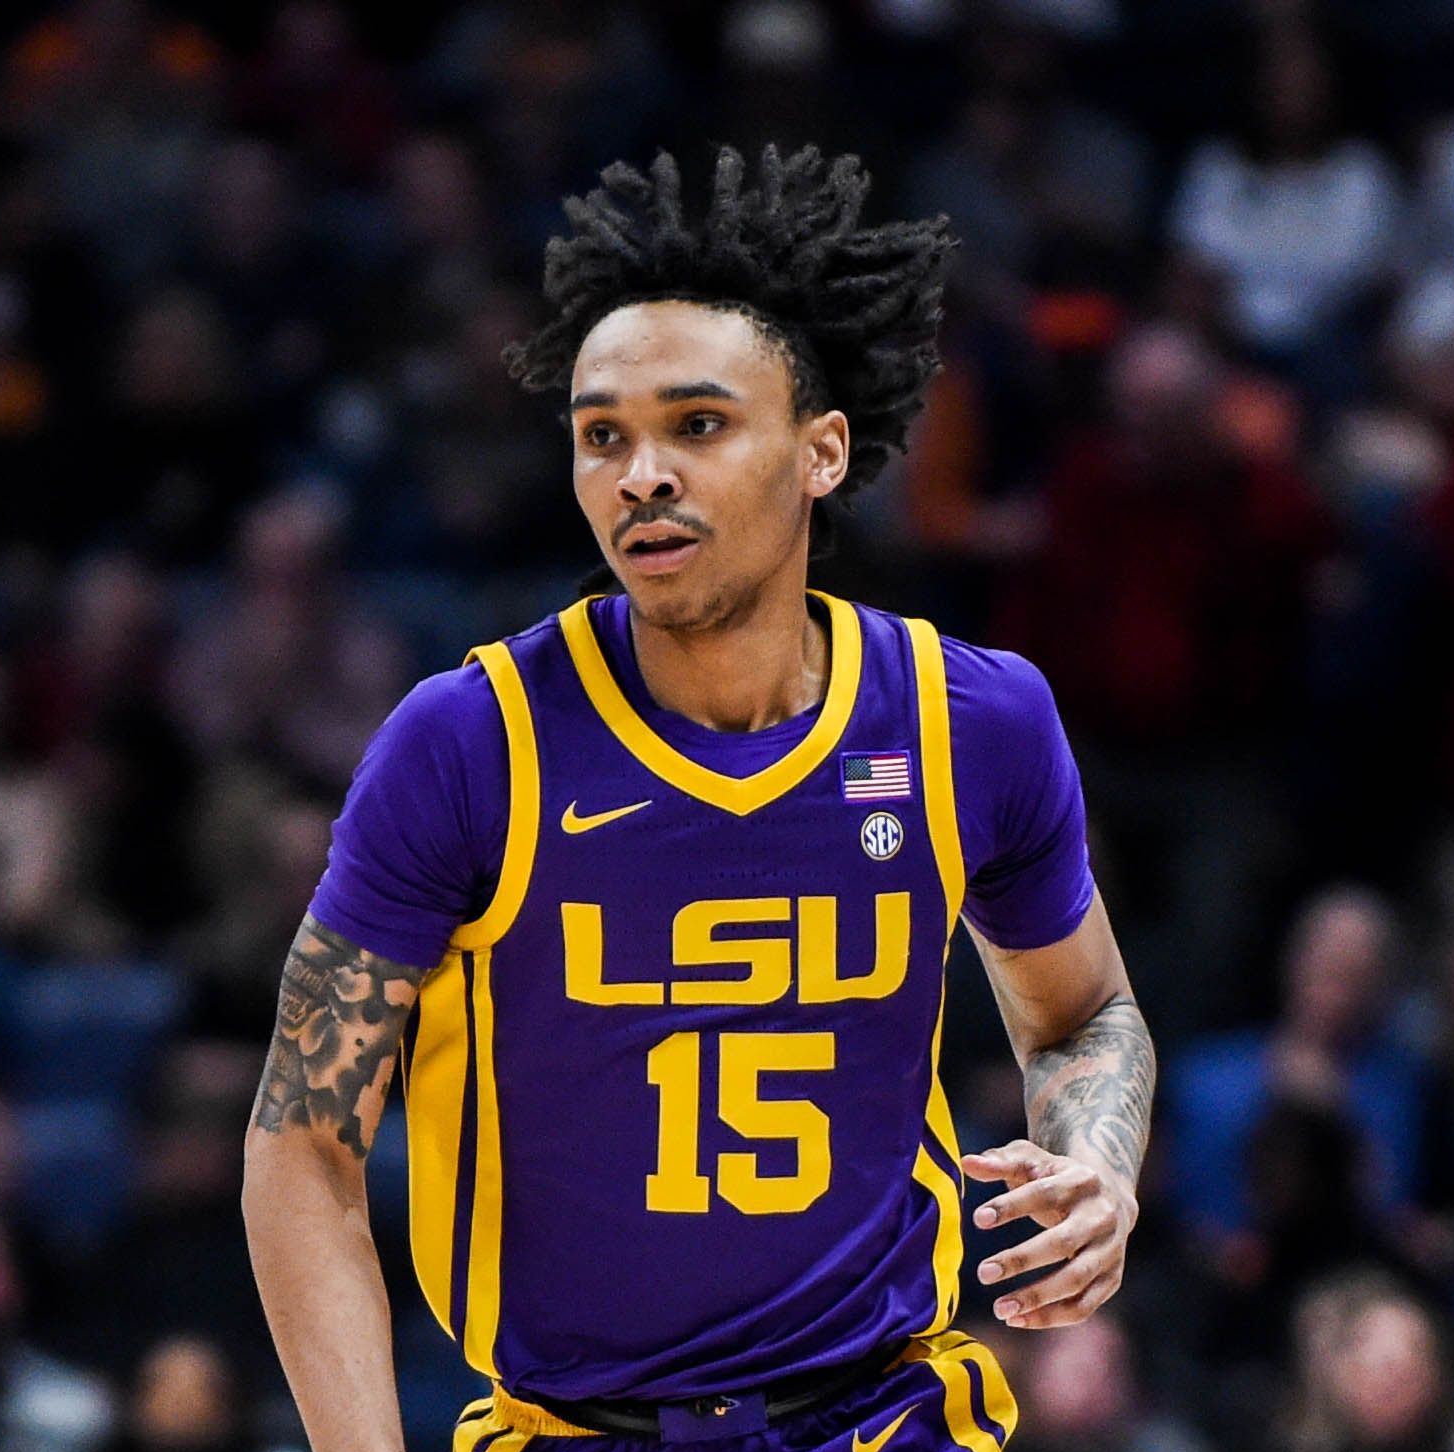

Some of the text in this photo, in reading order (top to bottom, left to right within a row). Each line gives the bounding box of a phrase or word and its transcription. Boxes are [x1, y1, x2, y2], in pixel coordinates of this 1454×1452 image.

[863, 814, 901, 858] SEC
[560, 891, 911, 1006] LSU
[646, 1031, 836, 1215] 15
